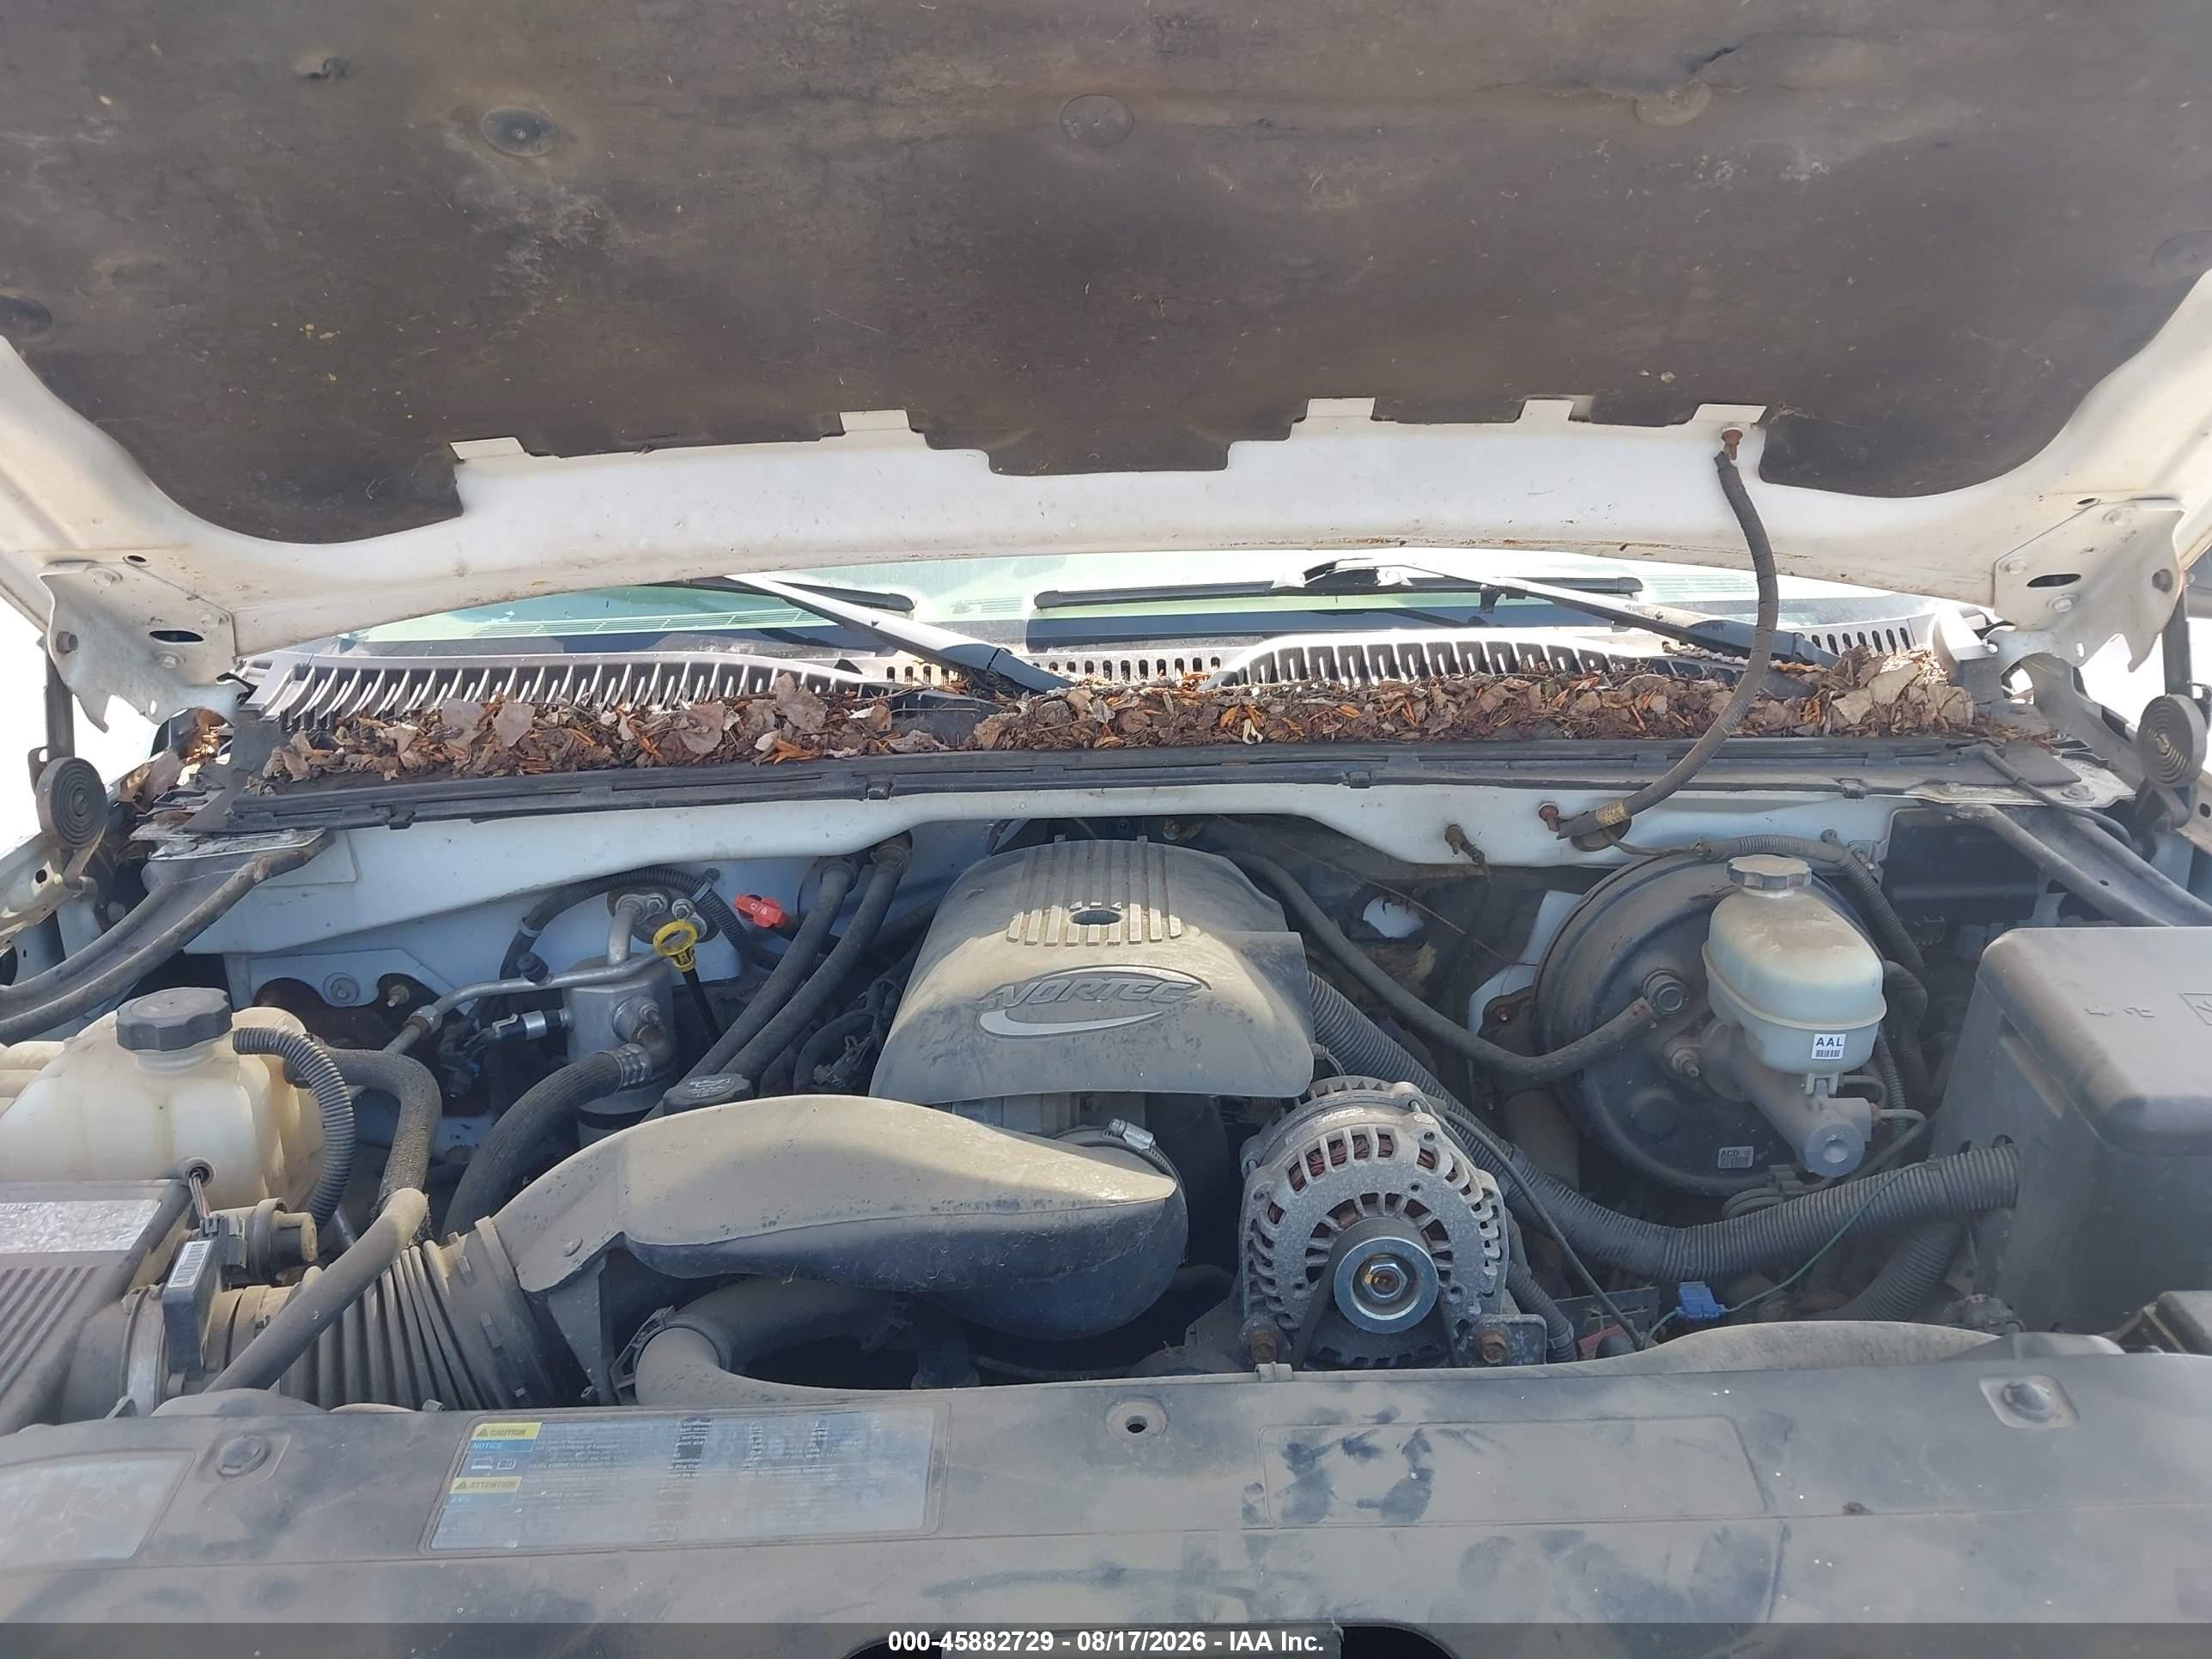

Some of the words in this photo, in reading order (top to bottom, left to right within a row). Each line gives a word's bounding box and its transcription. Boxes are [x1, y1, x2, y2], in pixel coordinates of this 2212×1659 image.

[982, 977, 1199, 1009] VORTEC
[1815, 1036, 1844, 1047] AAL
[471, 1442, 503, 1450] NOTICE
[468, 1480, 517, 1490] ATTENTION
